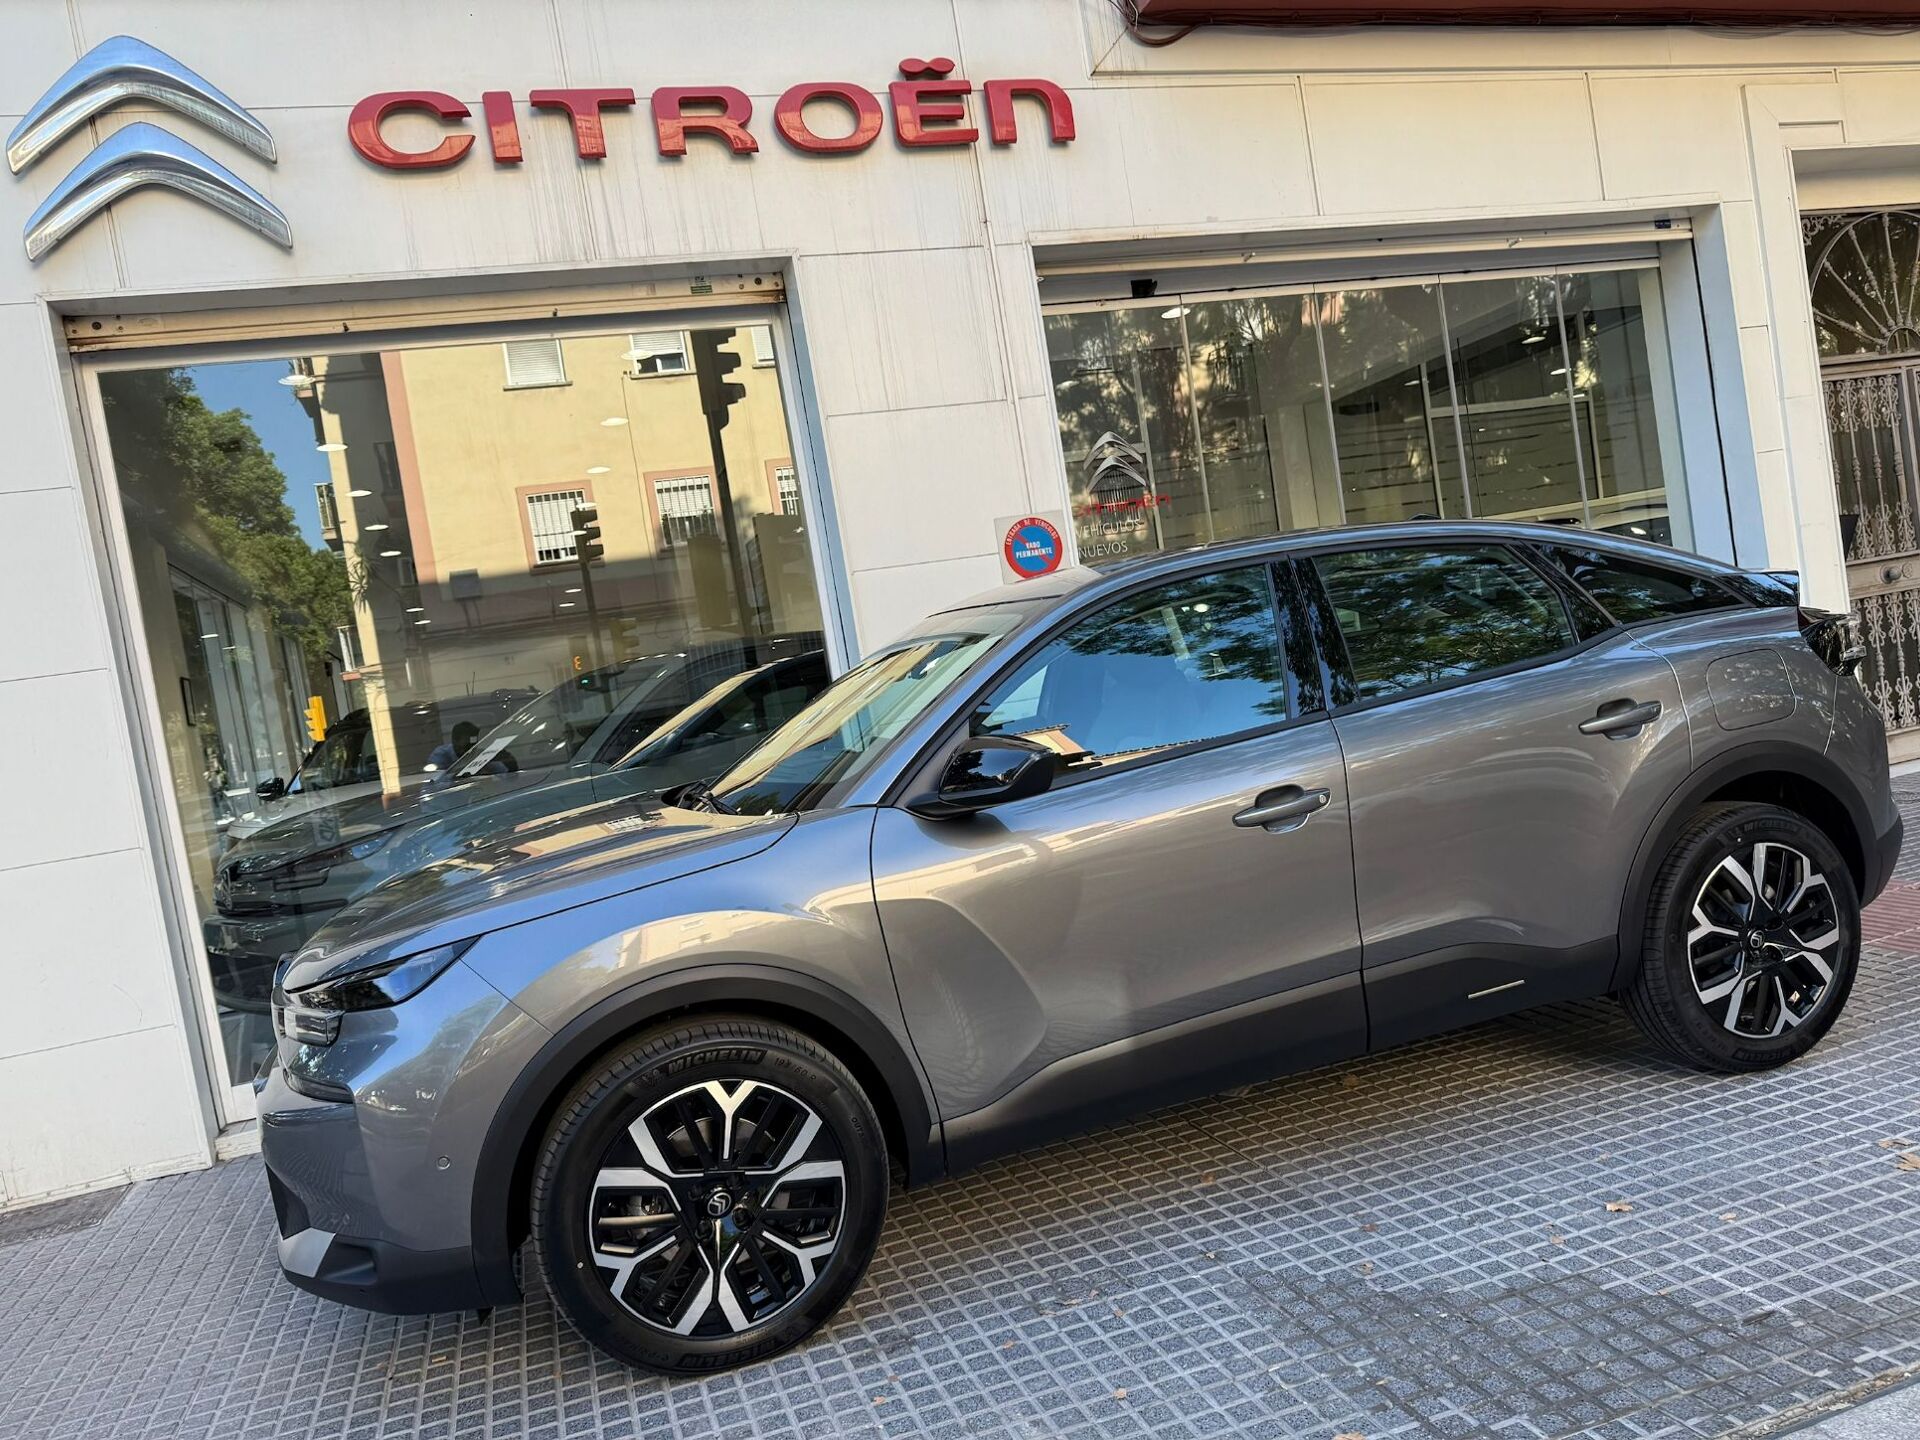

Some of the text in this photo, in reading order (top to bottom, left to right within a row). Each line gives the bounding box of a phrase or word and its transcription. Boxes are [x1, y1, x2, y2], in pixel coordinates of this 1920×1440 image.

[1025, 541, 1041, 549] VADO
[1078, 541, 1128, 558] NUEVOS
[1015, 547, 1053, 559] PERMANENTE
[667, 1050, 762, 1075] MICHELIN
